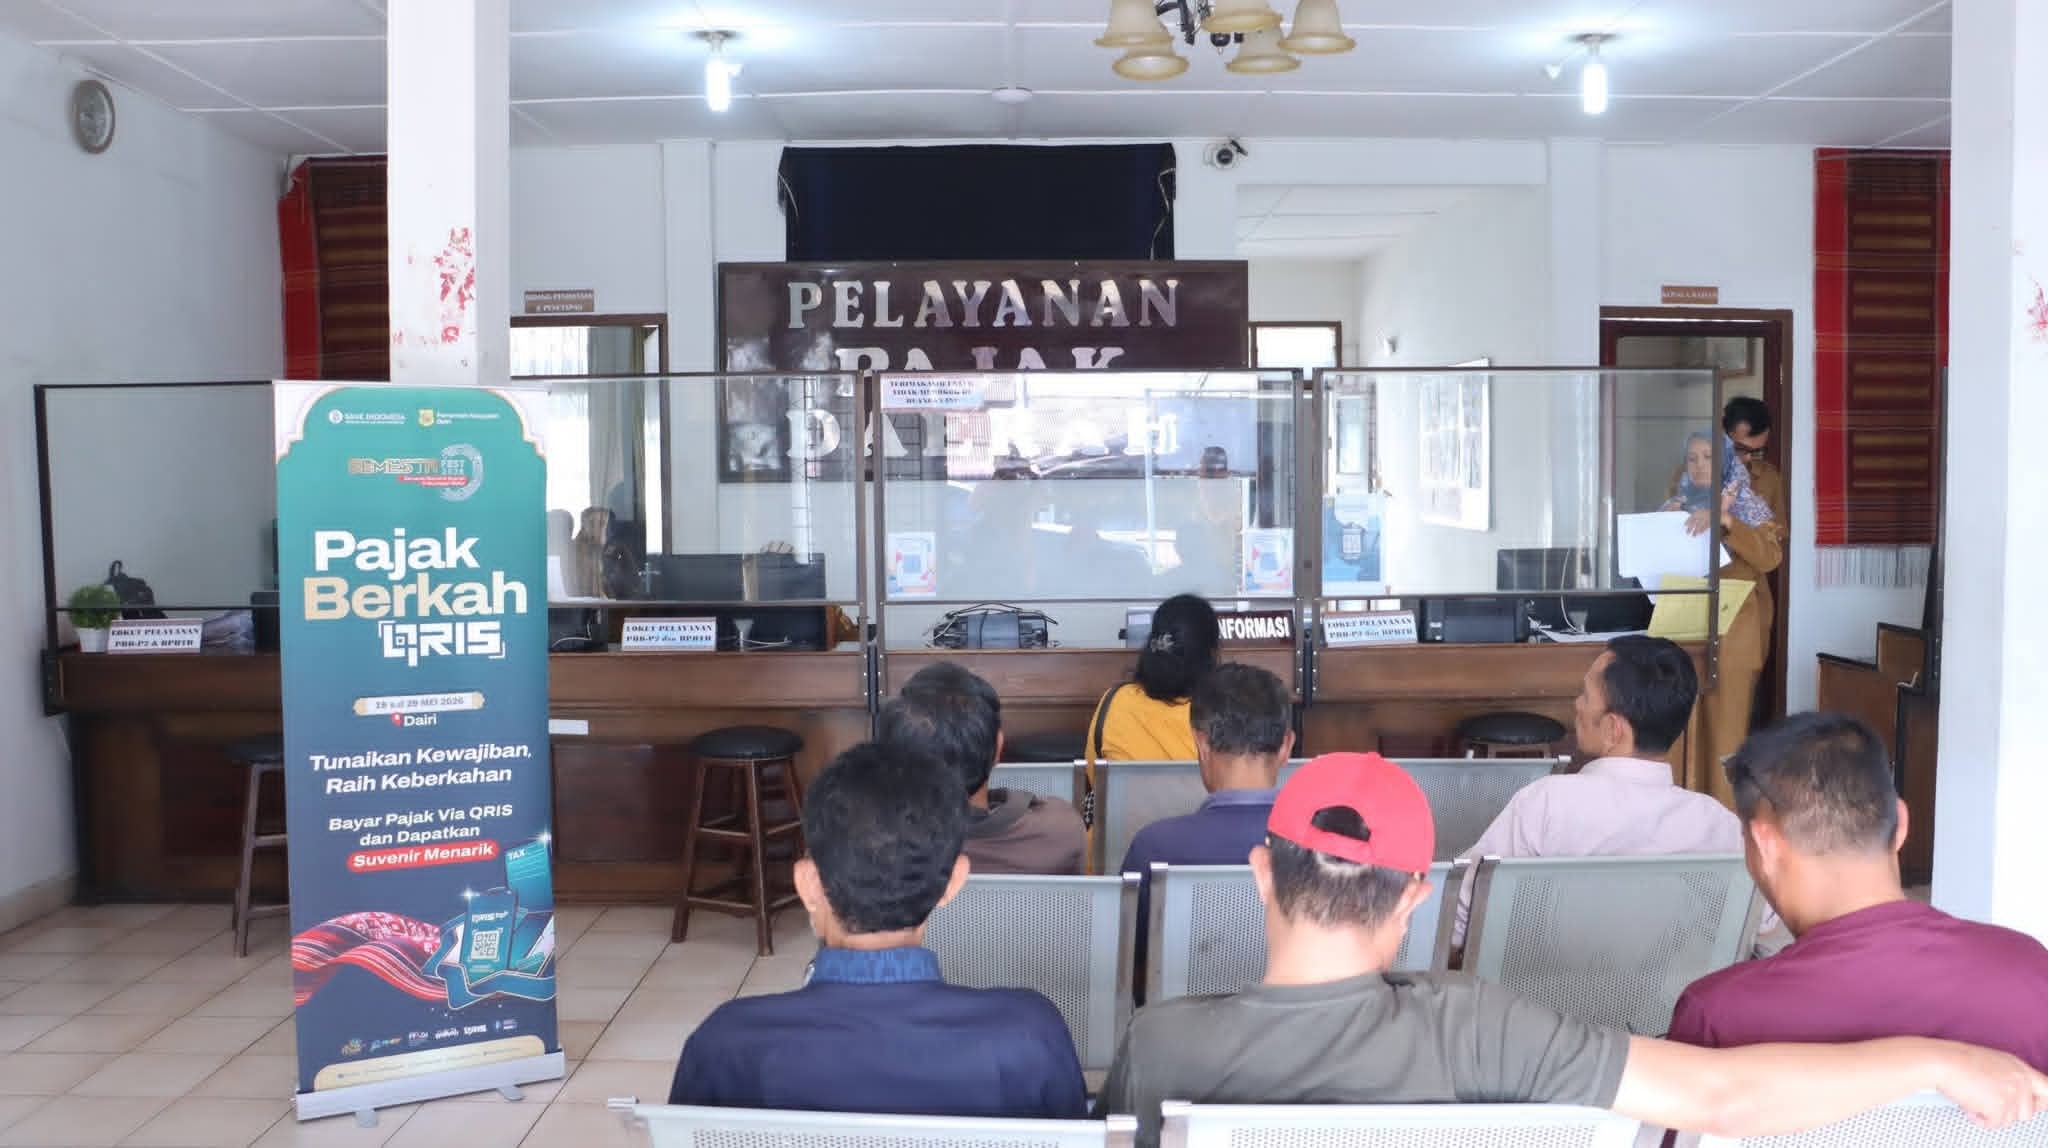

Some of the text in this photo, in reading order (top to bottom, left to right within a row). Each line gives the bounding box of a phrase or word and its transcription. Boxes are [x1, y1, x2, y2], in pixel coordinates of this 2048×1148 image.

[787, 279, 1179, 328] PELAYANAN
[314, 527, 480, 581] Pajak
[303, 571, 527, 620] Berkah
[111, 628, 199, 637] LOKET PELAYANAN
[1218, 616, 1290, 639] NFORMASI
[1327, 617, 1414, 629] LOKET PELAYANAN
[379, 620, 504, 667] QRIS
[403, 713, 437, 727] Dairi
[310, 743, 532, 771] Tunaikan Kewajiban,
[325, 768, 512, 794] Raih Keberkahan
[329, 804, 513, 832] Bayar Pajak Via QRIS
[359, 825, 480, 847] dan Dapatkan
[353, 843, 493, 867] Suvenir Menarik
[508, 850, 525, 861] TAX
